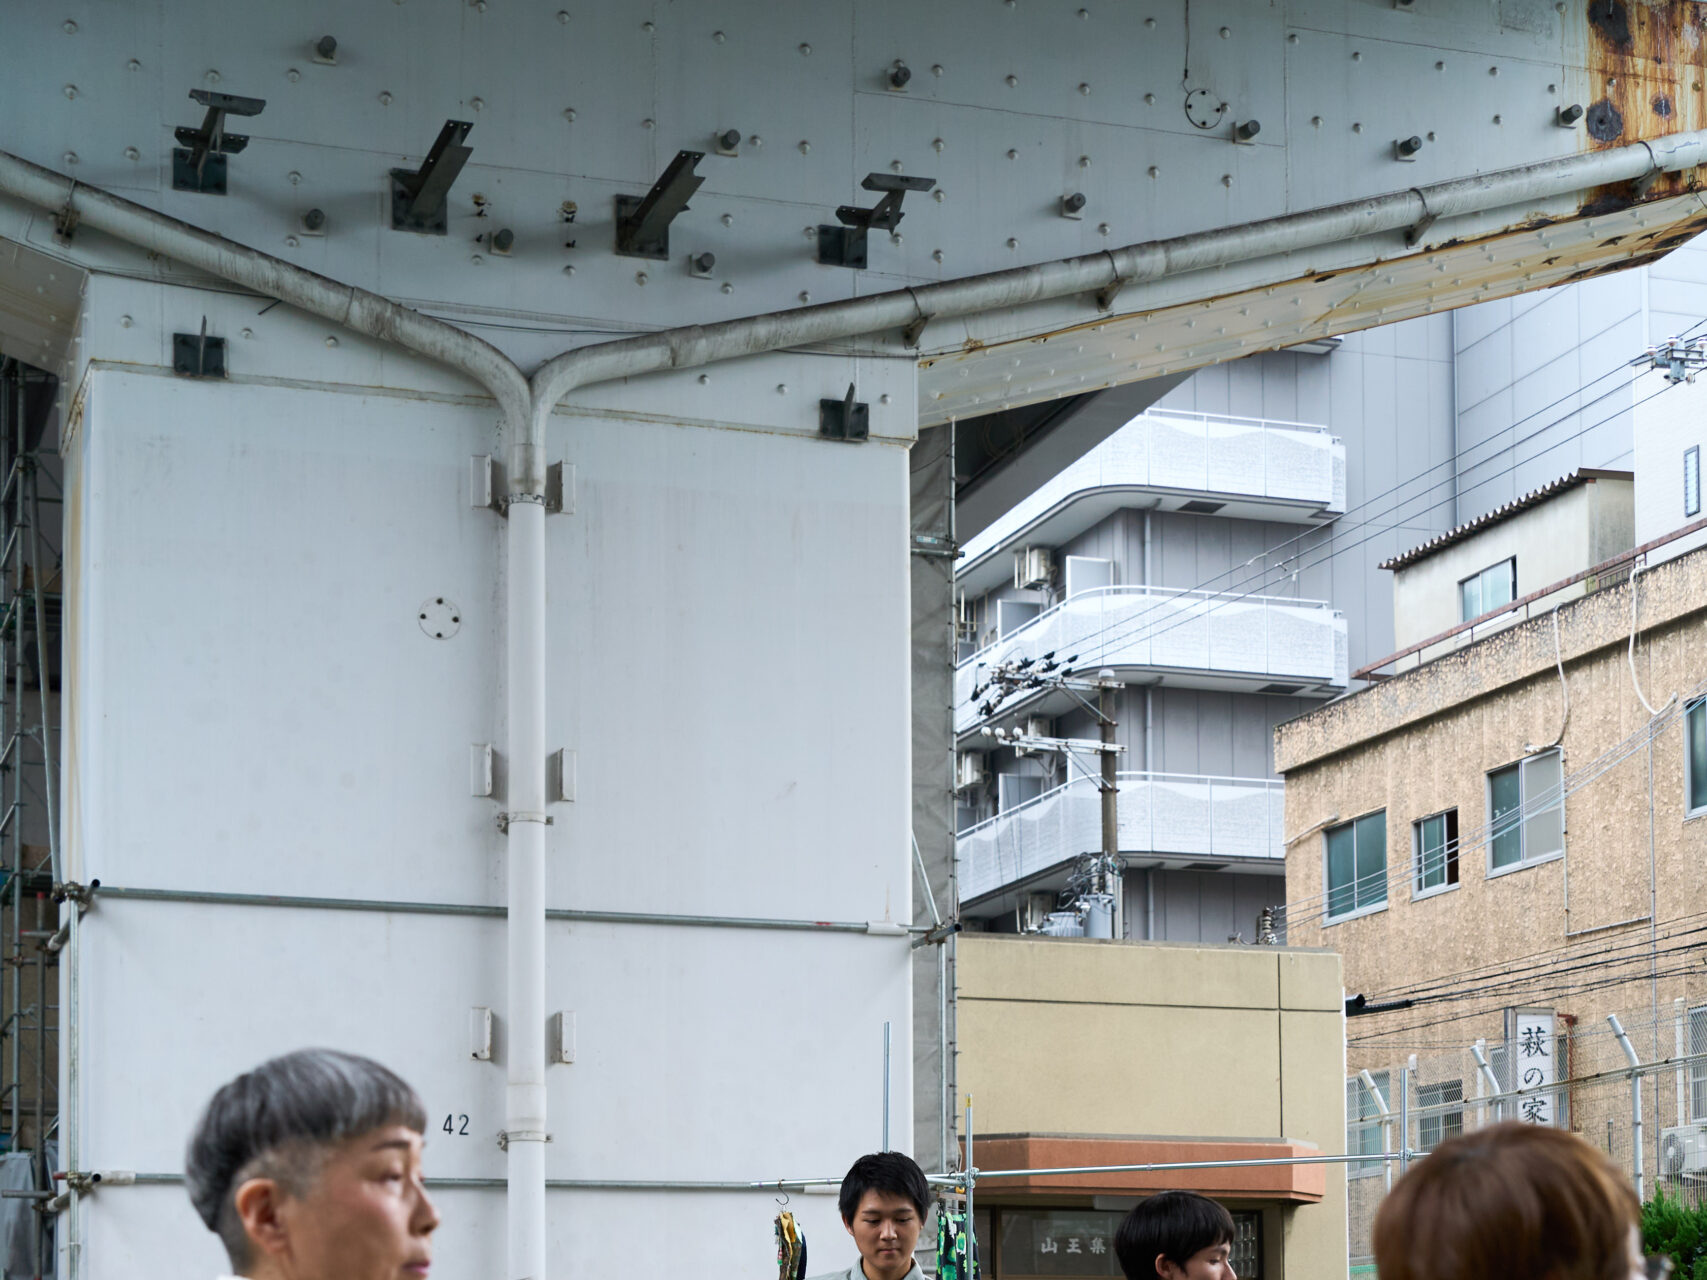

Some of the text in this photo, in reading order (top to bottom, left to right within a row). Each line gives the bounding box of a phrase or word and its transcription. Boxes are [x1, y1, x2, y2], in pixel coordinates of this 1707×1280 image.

[1520, 1025, 1549, 1124] 萩の家
[442, 1113, 470, 1136] 42
